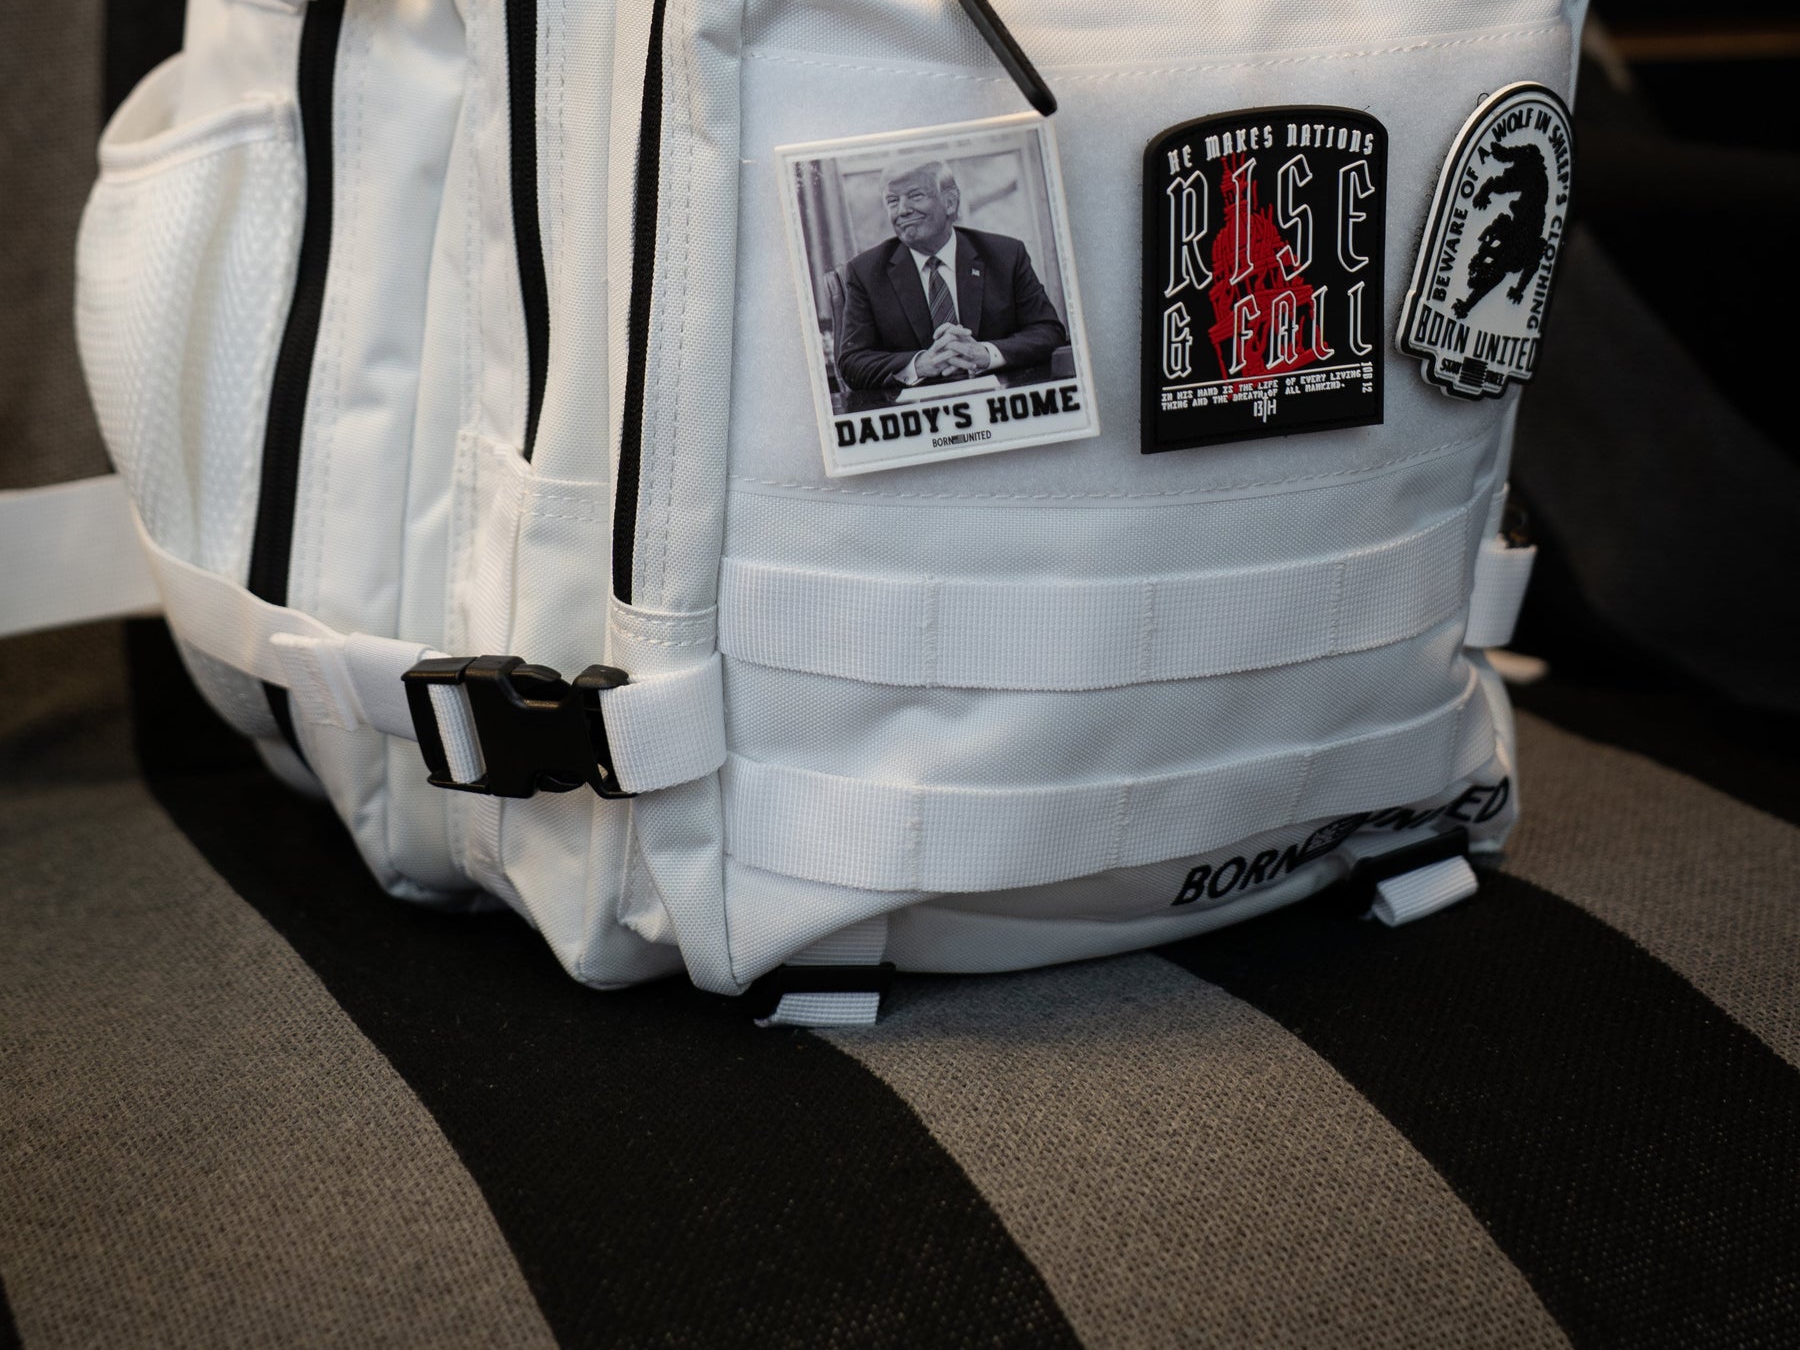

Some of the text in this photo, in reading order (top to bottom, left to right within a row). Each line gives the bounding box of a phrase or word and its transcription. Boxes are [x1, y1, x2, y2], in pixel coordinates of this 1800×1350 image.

[1491, 107, 1534, 143] WOLF
[1534, 109, 1552, 133] IN
[1167, 123, 1374, 175] HE MAKES NATIONS
[1477, 145, 1491, 165] A
[1460, 166, 1478, 200] OF
[1164, 153, 1375, 298] RISE
[1432, 207, 1468, 302] BEWARE
[1526, 215, 1563, 330] CLOTHING
[1229, 281, 1372, 375] FALL
[1414, 303, 1538, 372] BORN UNITED
[1161, 400, 1188, 411] THING
[1192, 397, 1208, 407] AND
[1212, 395, 1228, 405] THE
[1285, 385, 1301, 395] ALL
[1222, 385, 1233, 394] IS
[1239, 383, 1253, 392] THE
[1285, 377, 1296, 386] OF
[1300, 373, 1326, 385] EVERY
[1330, 369, 1361, 381] LIVING
[1362, 382, 1373, 393] 12
[834, 385, 1081, 448] DADDY'S HOME
[932, 429, 992, 448] BORN UNITED
[1170, 842, 1305, 906] BORN
